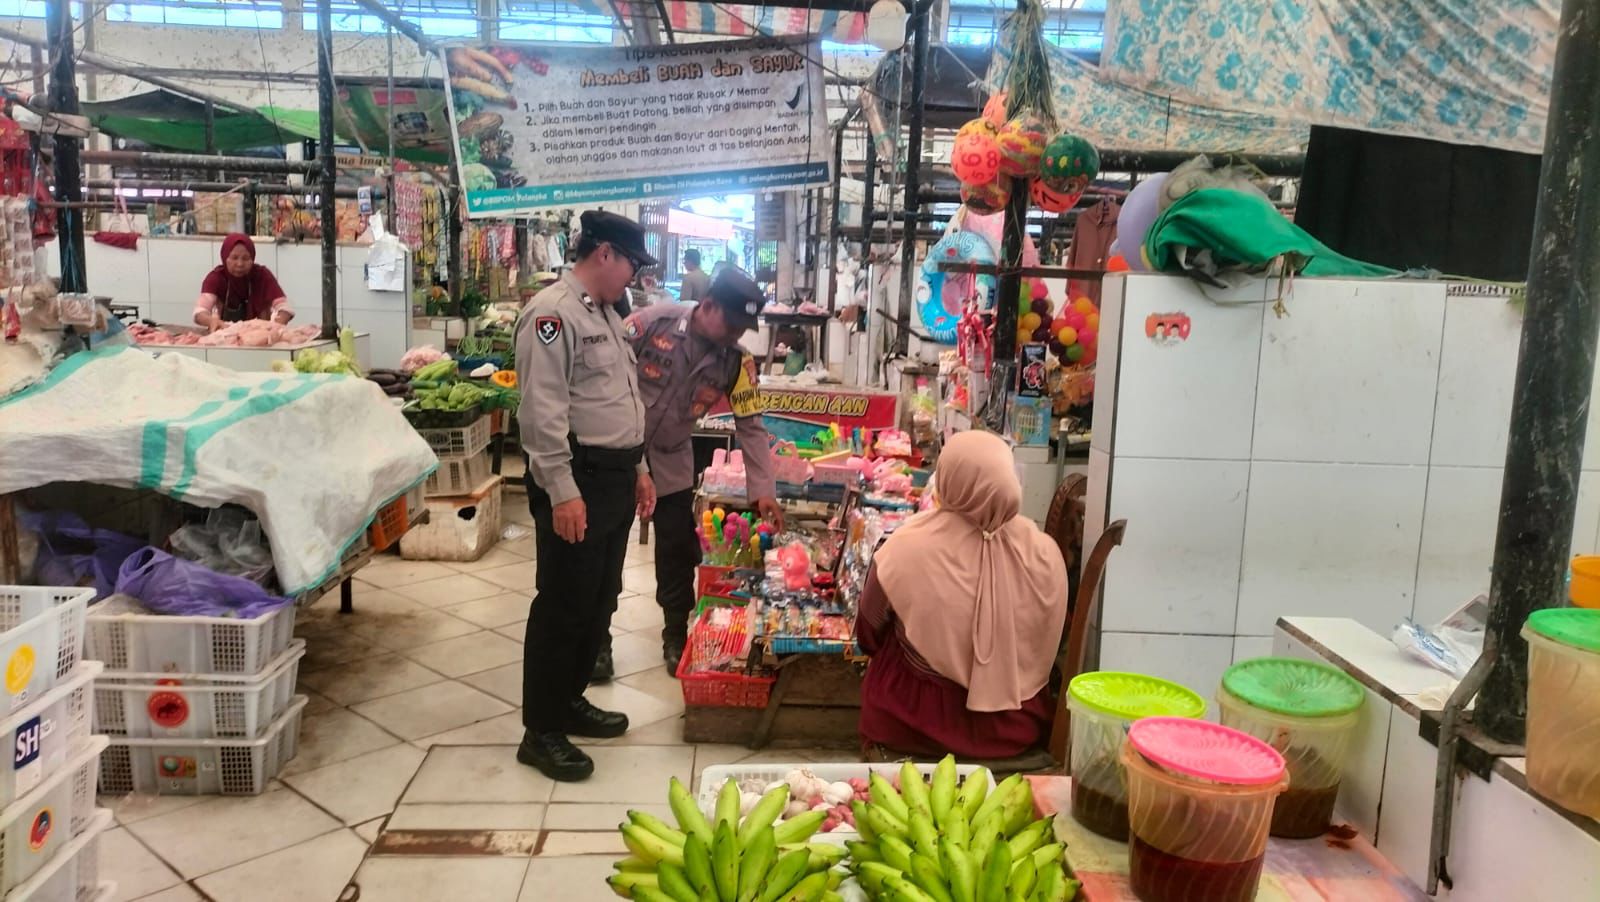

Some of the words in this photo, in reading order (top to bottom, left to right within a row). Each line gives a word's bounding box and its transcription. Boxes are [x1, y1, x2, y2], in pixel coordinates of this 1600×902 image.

[580, 69, 649, 87] Membeli
[657, 63, 703, 81] BUAH
[711, 58, 742, 77] dan
[750, 54, 804, 73] SAYUR
[524, 103, 534, 112] 1.
[539, 101, 558, 112] Pilih
[560, 101, 584, 110] Buah
[587, 99, 605, 108] dan
[608, 97, 639, 108] Sayur
[642, 95, 666, 105] yang
[670, 92, 693, 102] tidak
[697, 89, 726, 99] Rusak
[737, 86, 770, 96] Memar
[525, 116, 536, 126] 2.
[541, 116, 560, 126] Jika
[562, 112, 604, 123] membeli
[606, 110, 629, 120] Buat
[707, 103, 730, 114] yang
[733, 100, 776, 111] disimpan
[530, 142, 540, 152] 3.
[544, 140, 587, 151] Pisahkan
[590, 137, 624, 149] produk
[628, 136, 652, 145] Buah
[654, 133, 672, 142] dan
[675, 130, 704, 141] Sayur
[708, 127, 728, 137] dari
[729, 125, 761, 136] Daging
[543, 127, 573, 138] dalam
[575, 124, 607, 136] lemari
[610, 121, 656, 133] pendingin
[546, 154, 579, 164] olahan
[581, 152, 617, 162] unggas
[620, 149, 638, 158] dan
[640, 147, 684, 157] makanan
[686, 143, 705, 153] laut
[709, 141, 717, 151] di
[720, 140, 736, 150] tas
[739, 138, 784, 149] belanjaan
[787, 134, 811, 144] Anda
[759, 391, 829, 414] RENGAN
[829, 395, 868, 416] AAN
[16, 725, 39, 762] SH
